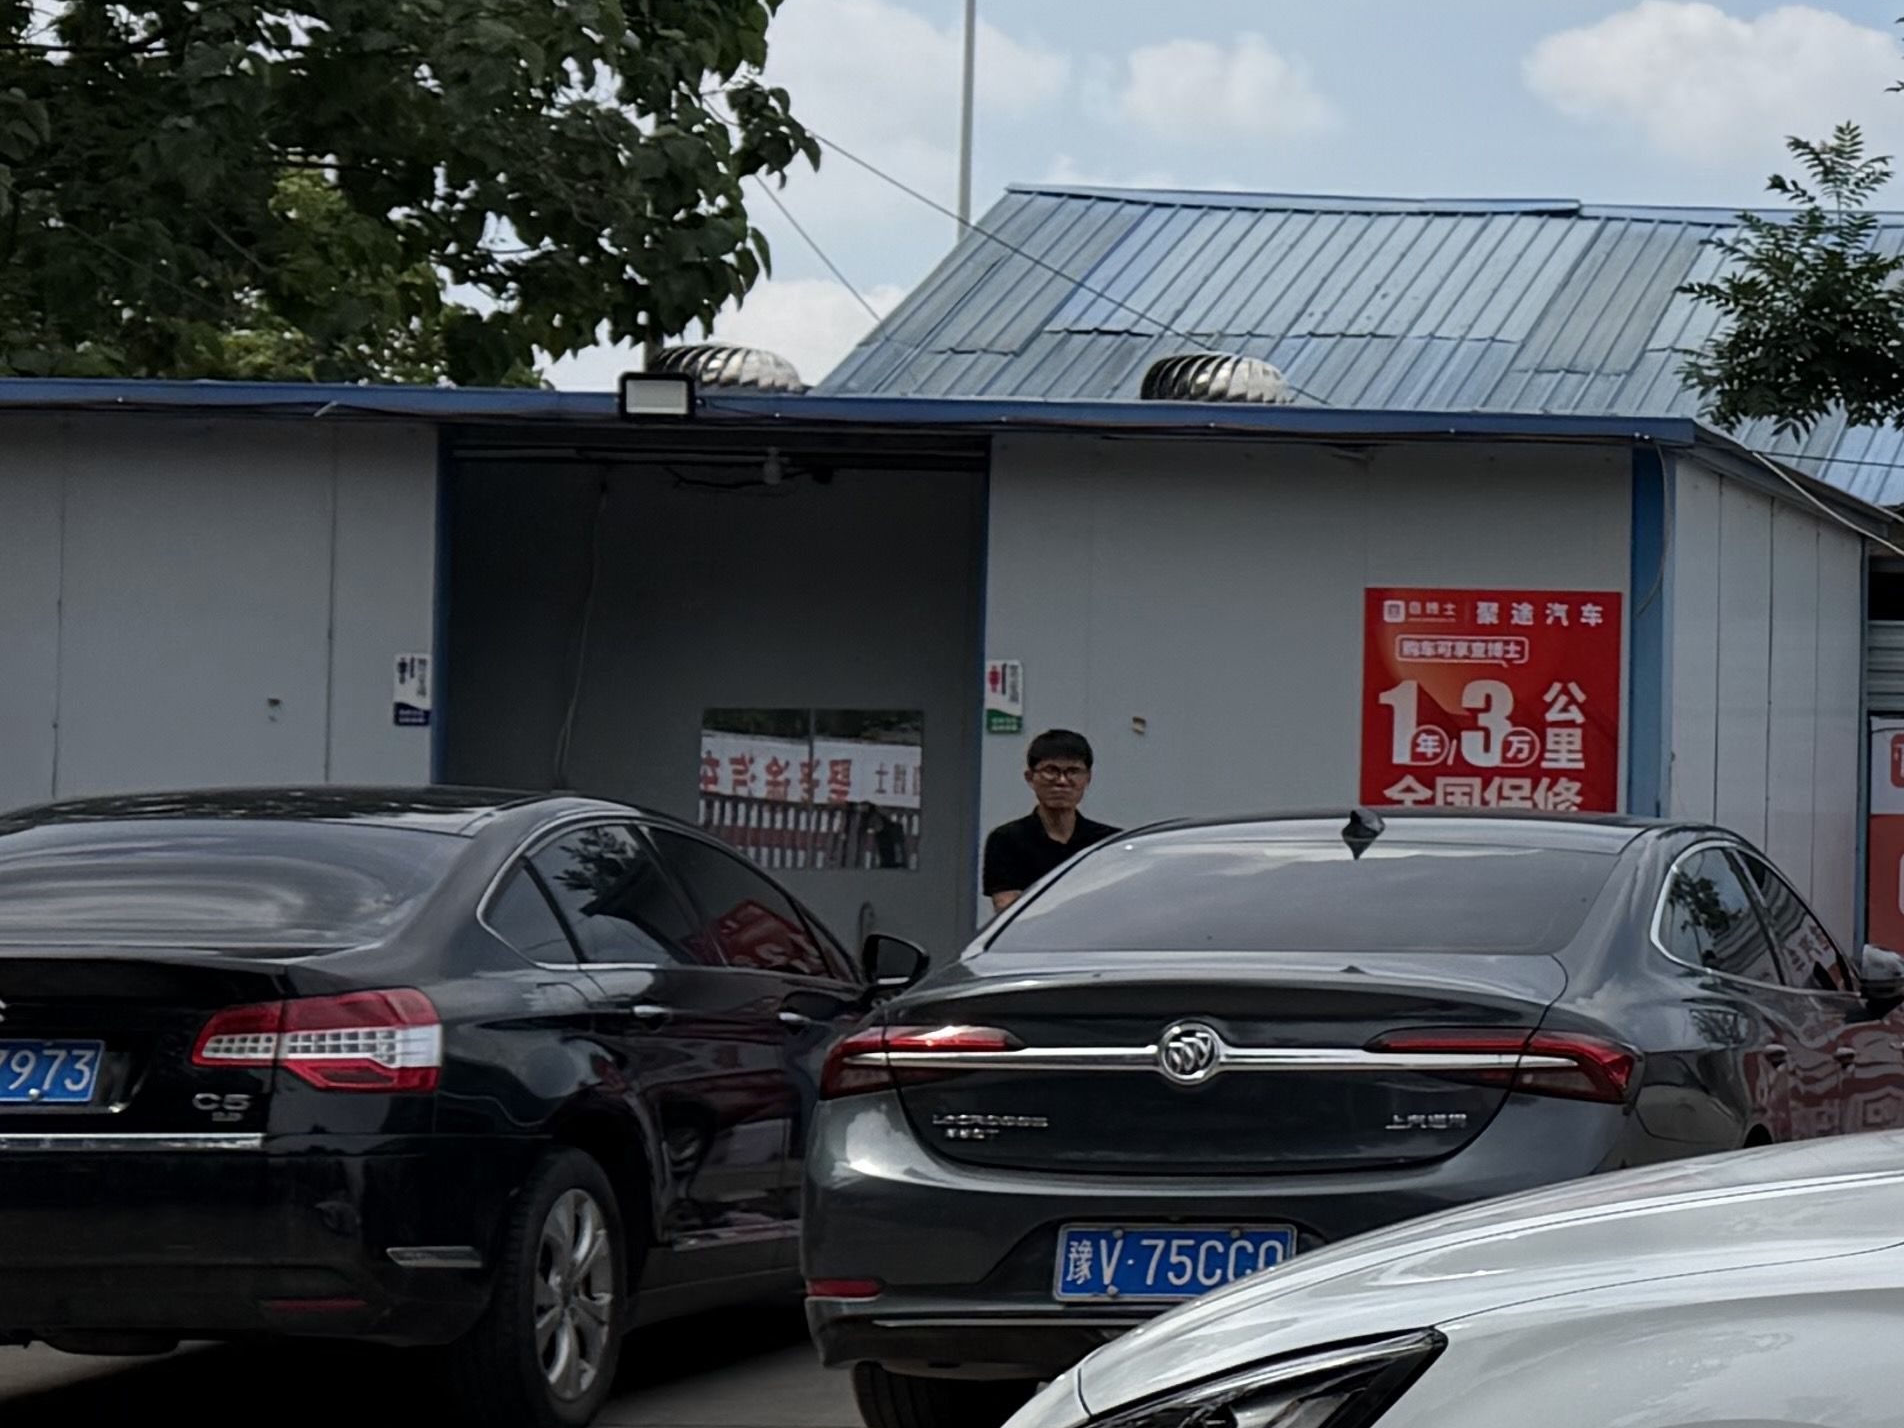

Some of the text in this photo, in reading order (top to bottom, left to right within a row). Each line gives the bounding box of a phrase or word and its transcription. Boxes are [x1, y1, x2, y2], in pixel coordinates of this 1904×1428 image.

[1476, 601, 1604, 627] 聚途汽车
[1403, 640, 1523, 660] 购车可享查博士
[0, 1048, 97, 1093] 973
[192, 1092, 256, 1111] C5
